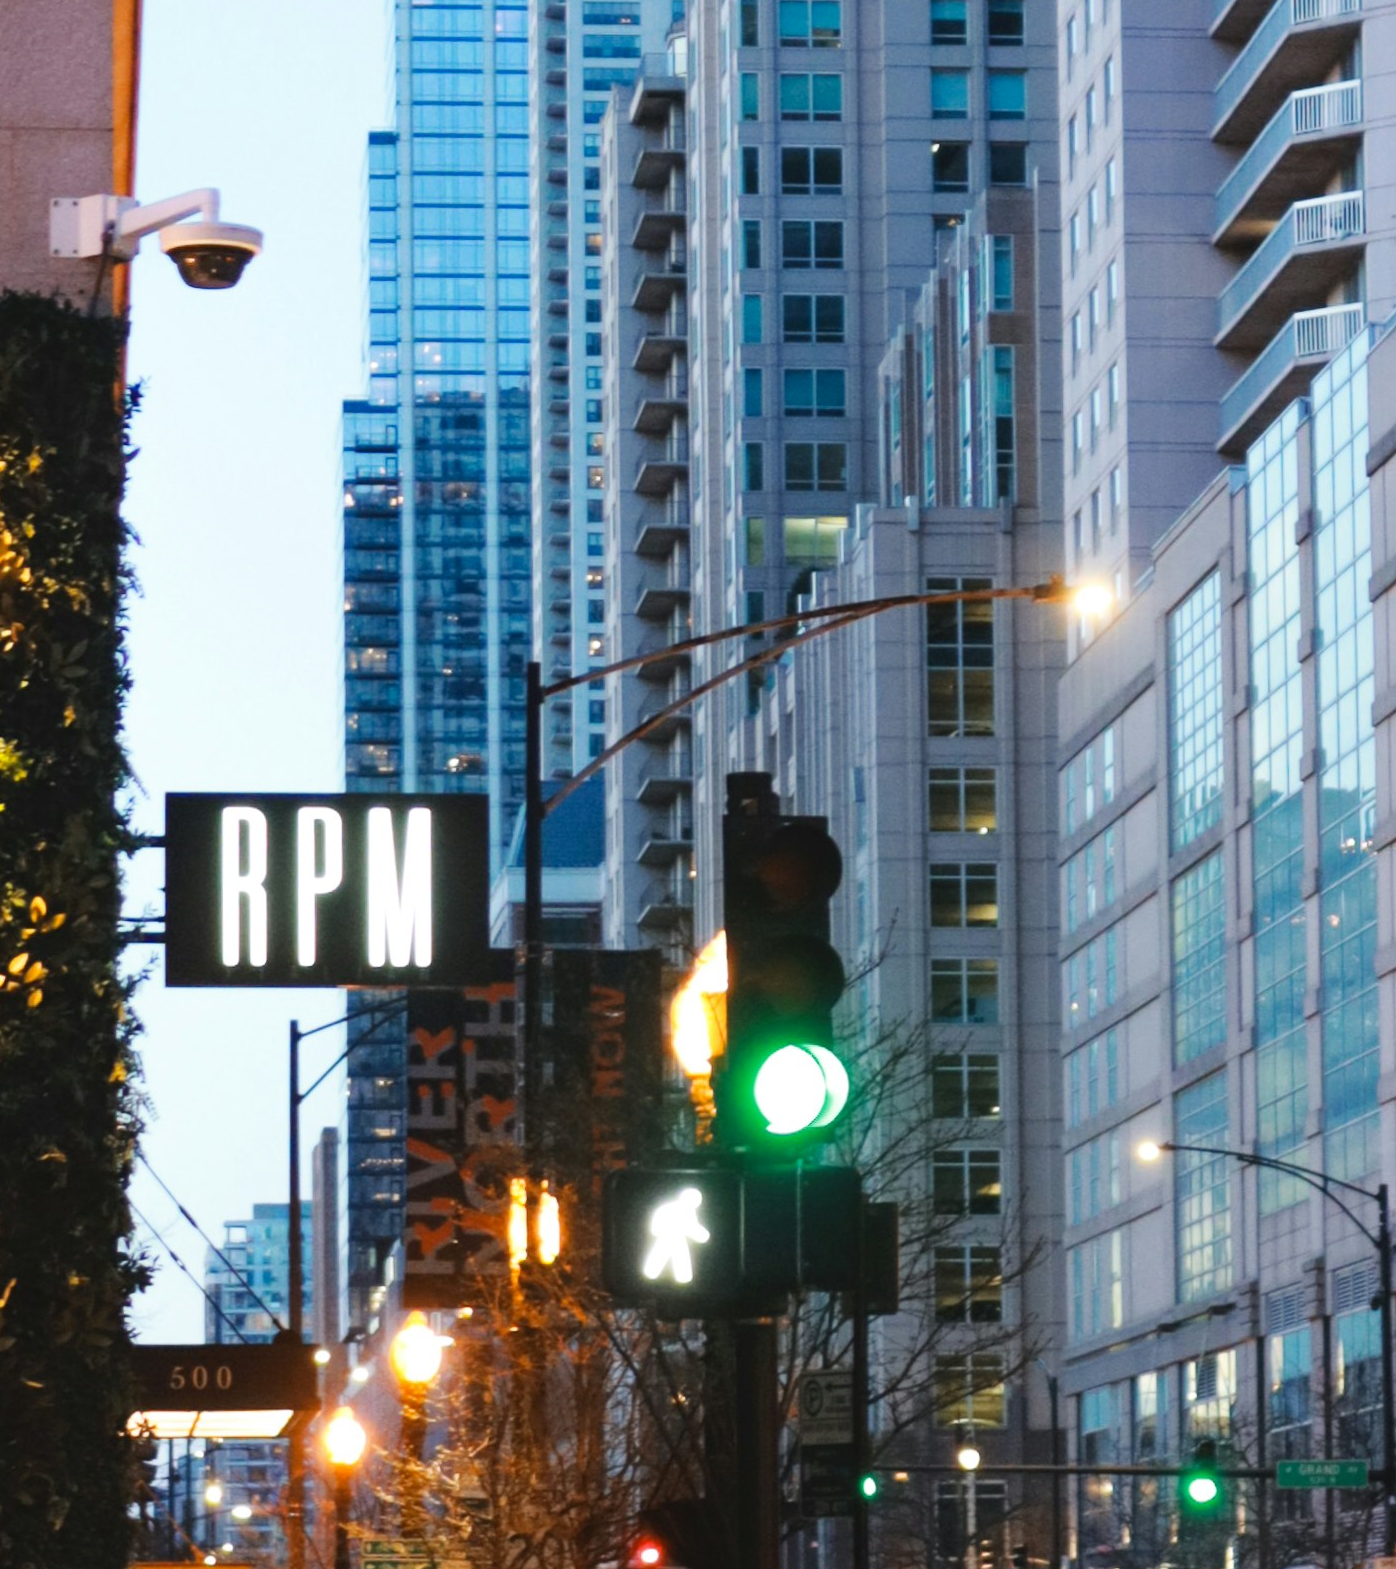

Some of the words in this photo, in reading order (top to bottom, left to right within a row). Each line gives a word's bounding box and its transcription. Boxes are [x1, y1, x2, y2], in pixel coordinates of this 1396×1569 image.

[221, 805, 433, 968] RPM
[405, 1026, 457, 1275] RIVER
[462, 983, 517, 1275] NORTH
[169, 1365, 233, 1390] 500
[1298, 1464, 1341, 1476] GRAND
